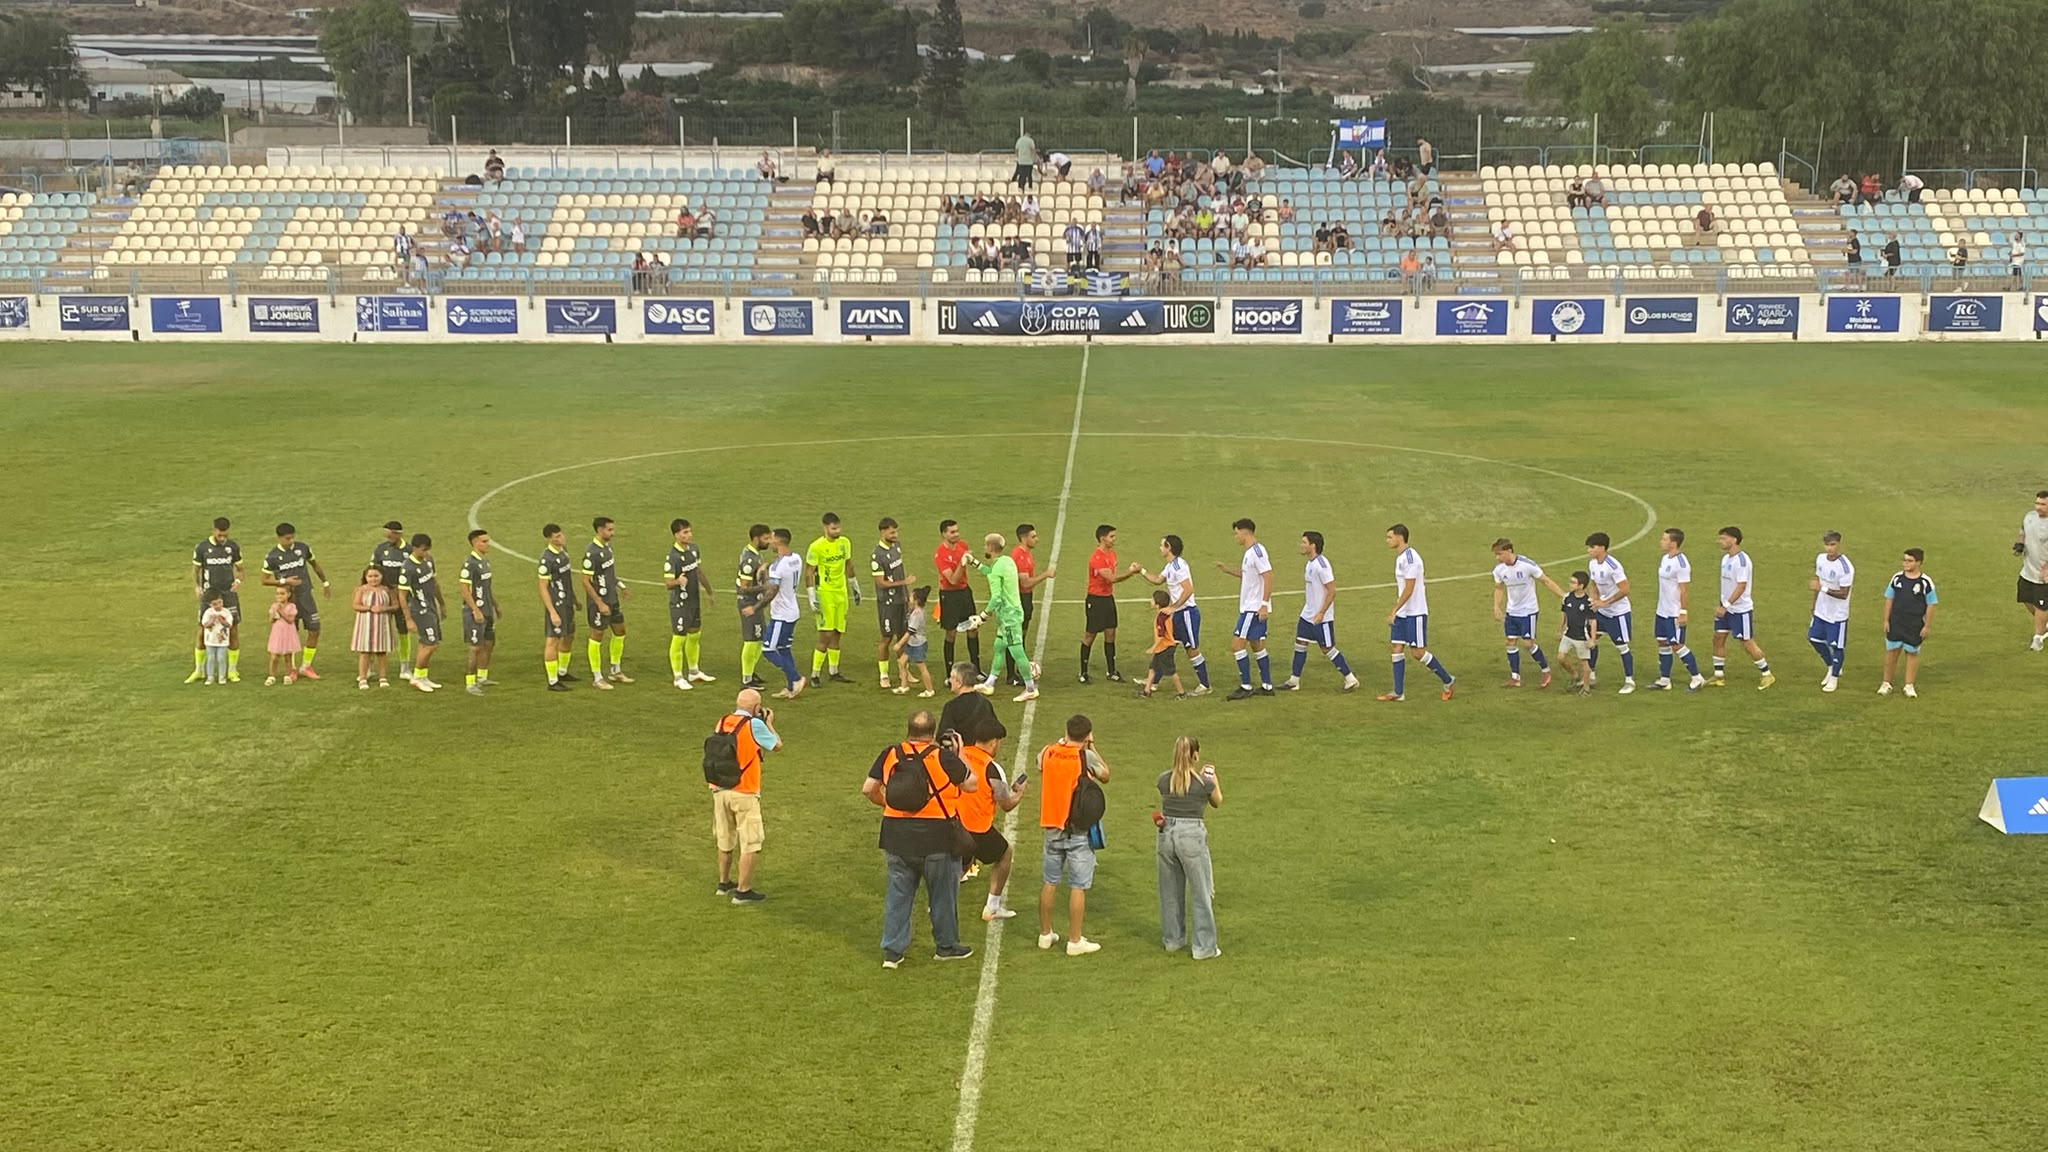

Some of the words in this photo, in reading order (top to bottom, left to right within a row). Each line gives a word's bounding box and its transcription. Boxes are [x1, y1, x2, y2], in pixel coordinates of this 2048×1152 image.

[80, 305, 99, 313] SUR
[101, 305, 126, 313] CREA
[382, 306, 422, 318] Salinas
[1051, 307, 1100, 318] COPA
[1955, 303, 1977, 315] RC
[270, 311, 313, 320] JOMISUR
[667, 307, 710, 324] ASC
[941, 306, 956, 329] FU
[1051, 318, 1100, 331] FEDERACIÓN
